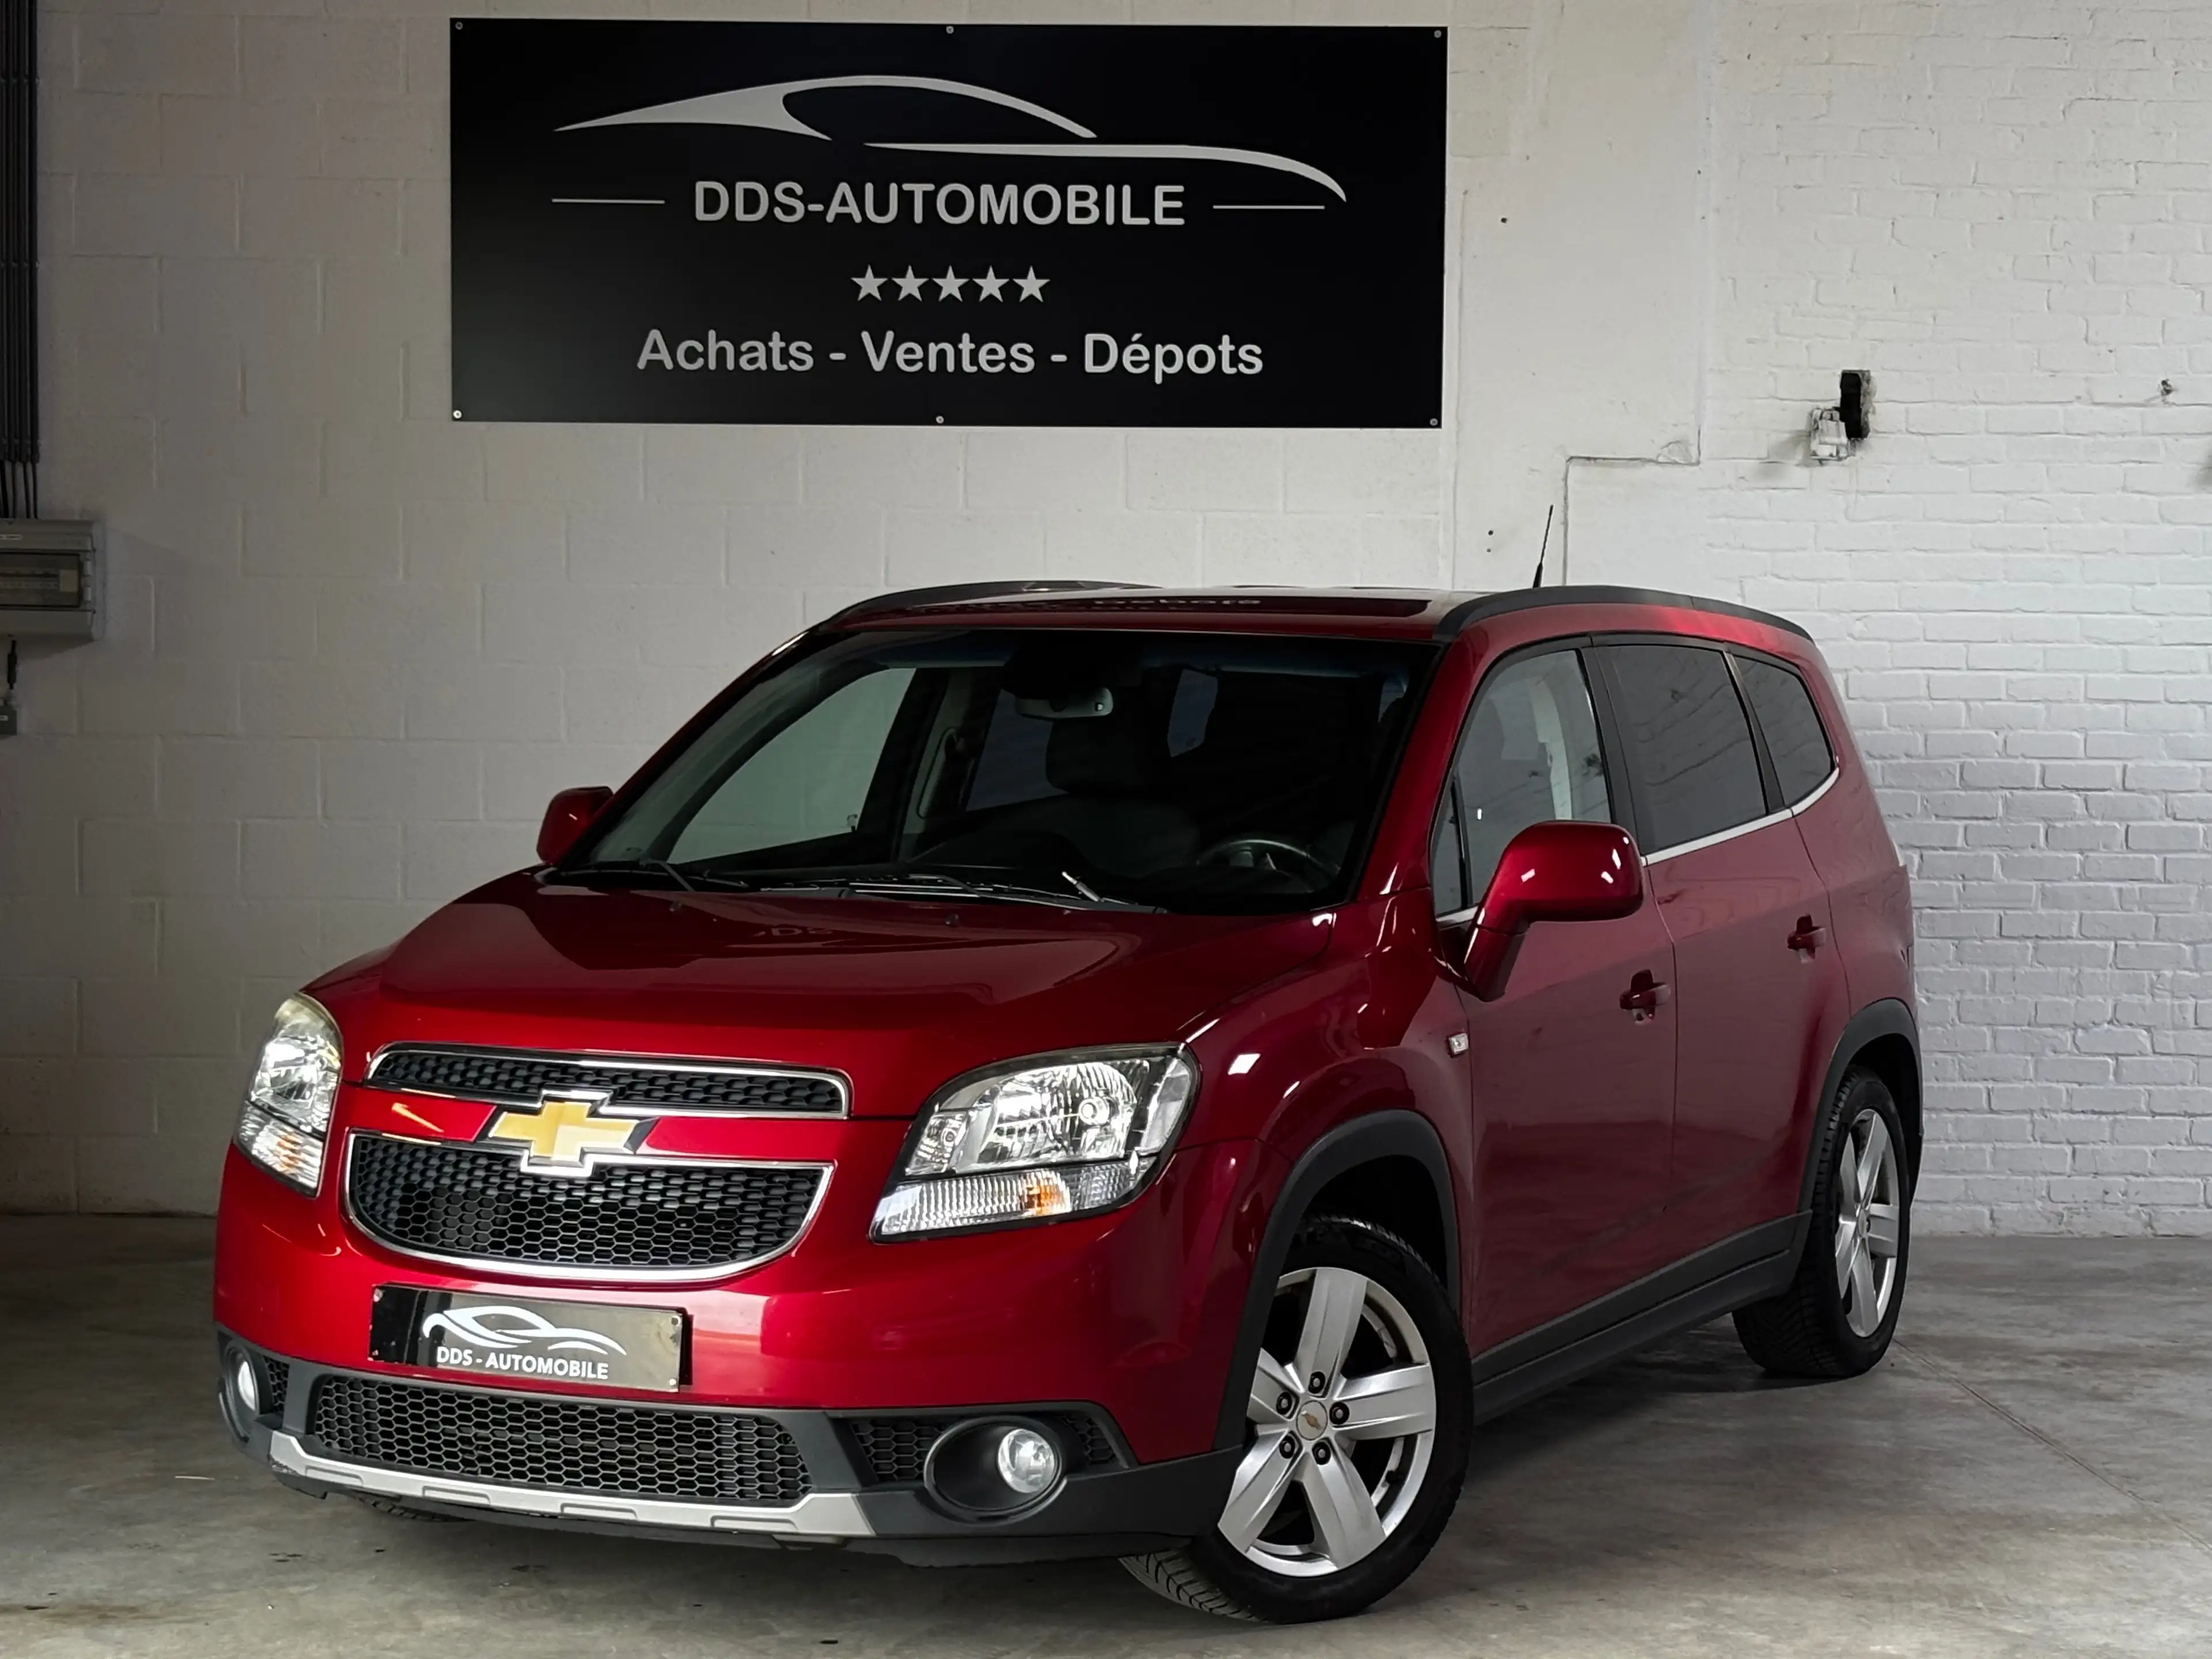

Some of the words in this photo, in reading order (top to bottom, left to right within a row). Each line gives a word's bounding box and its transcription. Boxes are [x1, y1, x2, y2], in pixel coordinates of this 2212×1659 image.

[695, 180, 1186, 226] DDS-AUTOMOBILE
[637, 328, 814, 372] Achats
[861, 329, 1036, 374] Ventes
[1084, 332, 1264, 385] Dépots
[437, 1346, 473, 1366] DDS
[485, 1352, 609, 1380] AUTOMOBILE
